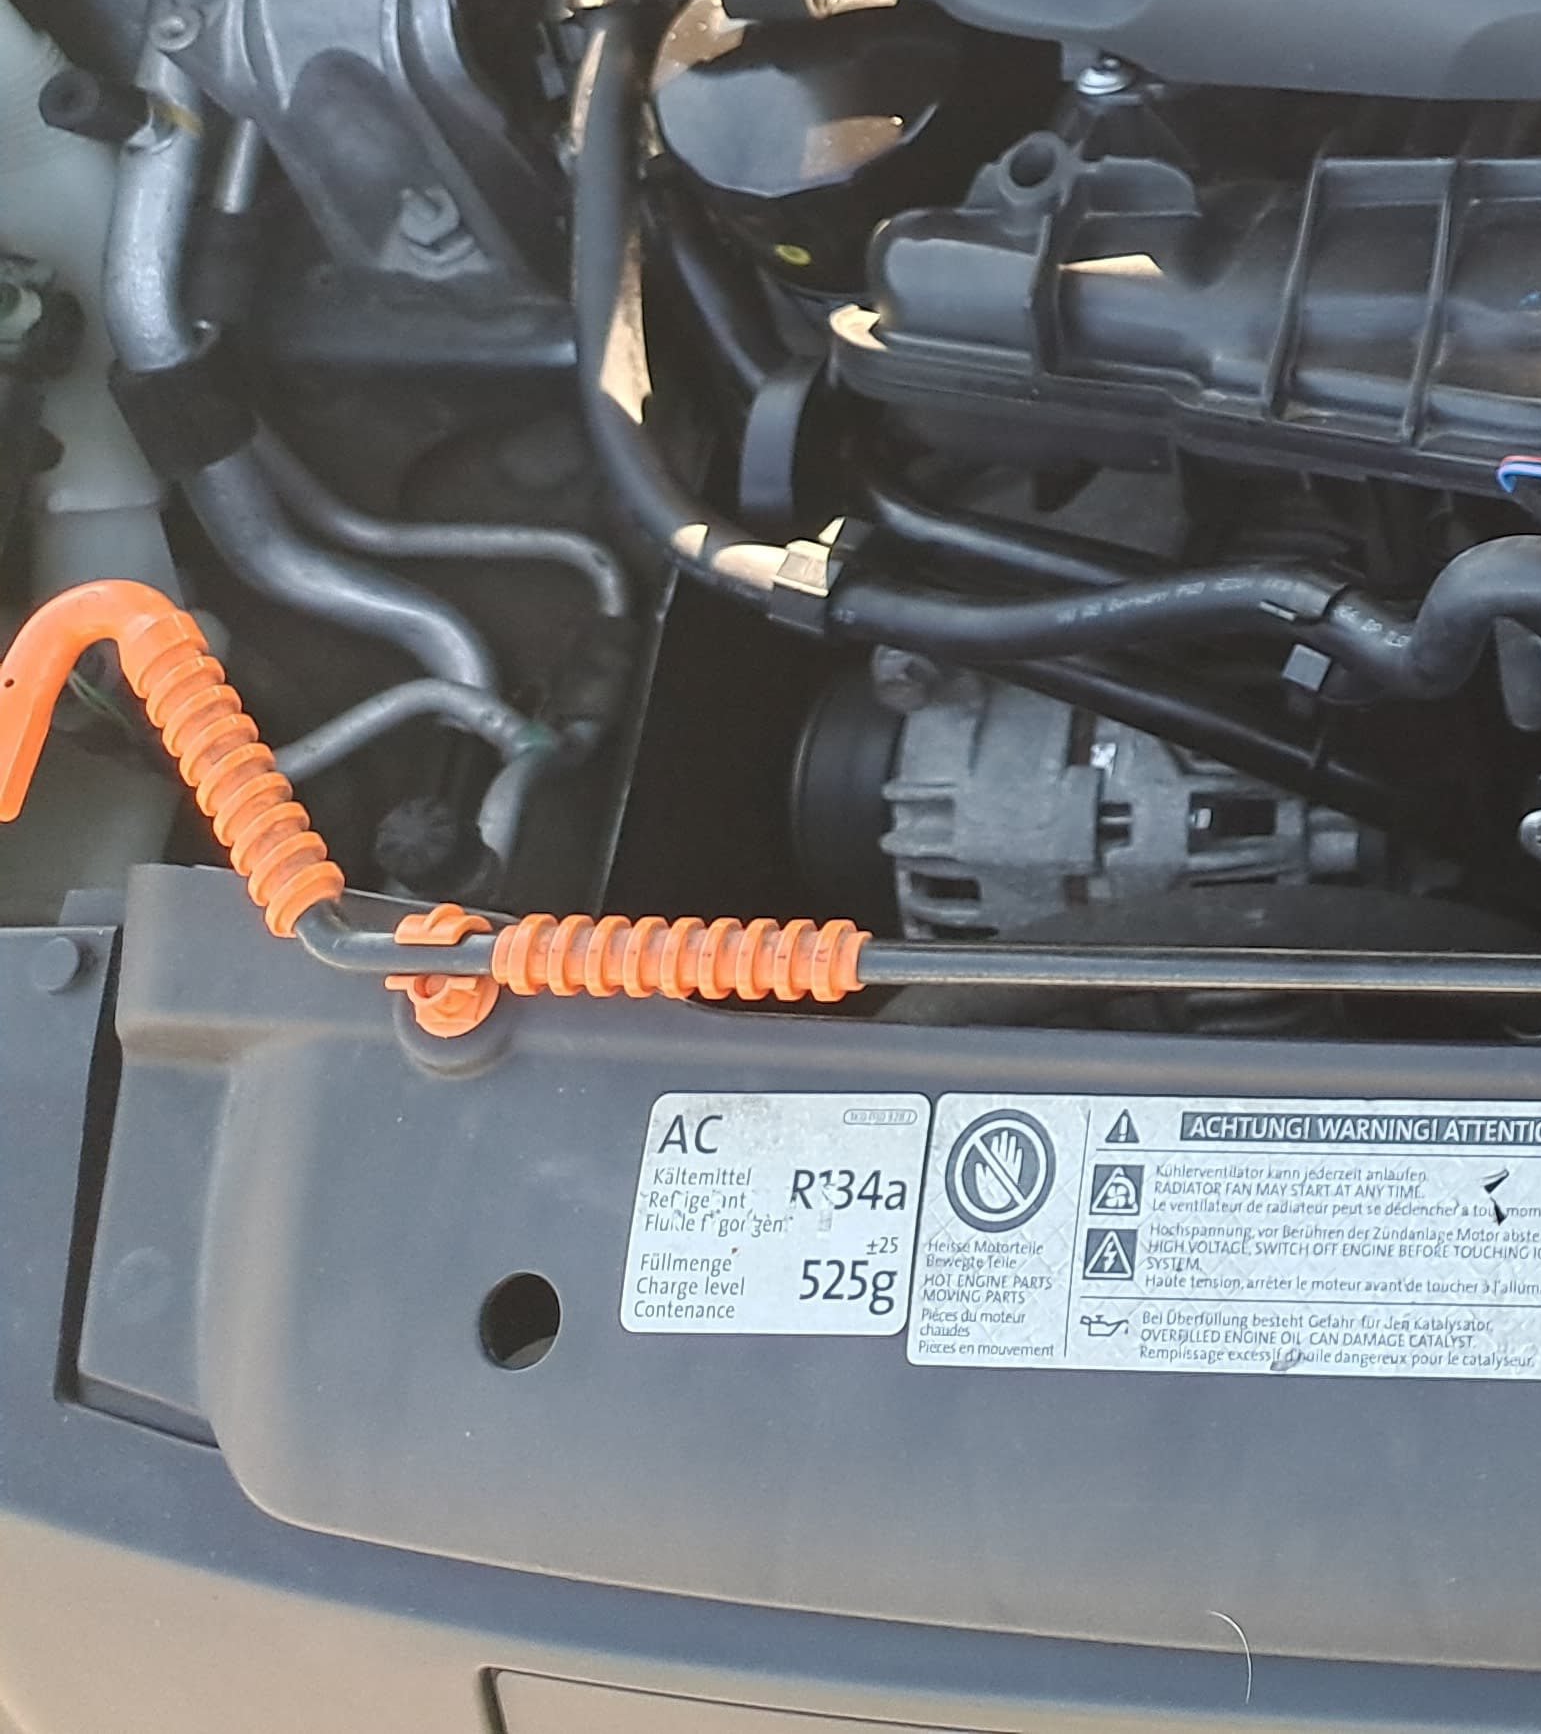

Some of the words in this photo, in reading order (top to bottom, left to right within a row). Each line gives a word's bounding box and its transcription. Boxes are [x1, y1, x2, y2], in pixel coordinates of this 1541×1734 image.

[657, 1114, 723, 1154] AC
[653, 1166, 752, 1186] Kältemittel
[1156, 1164, 1264, 1179] Kühlerventilator
[1267, 1165, 1300, 1180] kann
[1302, 1167, 1362, 1183] jederzeit
[1154, 1181, 1221, 1195] RADIATOR
[1225, 1182, 1253, 1196] FAN
[1257, 1183, 1286, 1197] MAY
[1290, 1183, 1331, 1197] START
[1335, 1184, 1352, 1197] AT
[1355, 1184, 1385, 1198] ANY
[1152, 1199, 1168, 1212] Le
[1170, 1200, 1243, 1214] ventilateur
[1246, 1201, 1263, 1214] de
[1266, 1201, 1329, 1215] radiateur
[1332, 1204, 1363, 1218] peut
[1367, 1205, 1384, 1215] se
[1258, 1227, 1279, 1237] vor
[1283, 1225, 1343, 1239] Berühren
[1348, 1227, 1369, 1239] der
[1373, 1228, 1453, 1244] Zündanlage
[1457, 1229, 1500, 1242] Motor
[866, 1236, 899, 1255] ±25
[974, 1241, 1043, 1256] Motorteile
[1147, 1240, 1185, 1253] HIGH
[1255, 1242, 1309, 1256] SWITCH
[1312, 1243, 1339, 1257] OFF
[1342, 1243, 1394, 1257] ENGINE
[1399, 1245, 1448, 1259] BEFORE
[1453, 1245, 1530, 1261] TOUCHING
[641, 1252, 732, 1278] Füllmenge
[988, 1255, 1017, 1269] Teile
[636, 1276, 698, 1301] Charge
[704, 1277, 745, 1296] level
[799, 1259, 898, 1316] 525g
[924, 1274, 951, 1287] HOT
[958, 1275, 1008, 1289] ENGINE
[1013, 1275, 1053, 1290] PARTS
[1145, 1276, 1186, 1288] Haute
[1189, 1276, 1244, 1291] tension,
[1295, 1278, 1308, 1290] le
[1311, 1279, 1363, 1292] moteur
[1365, 1280, 1404, 1292] avant
[1406, 1281, 1423, 1293] de
[1427, 1281, 1479, 1294] toucher
[923, 1289, 981, 1303] MOVING
[985, 1291, 1025, 1304] PARTS
[634, 1300, 735, 1319] Contenance
[961, 1312, 977, 1323] du
[980, 1313, 1025, 1324] moteur
[919, 1323, 970, 1337] chaudes
[1142, 1312, 1162, 1325] Bei
[1252, 1314, 1304, 1328] besteht
[1308, 1315, 1355, 1329] Gefahr
[1140, 1329, 1221, 1344] OVERFILLED
[1224, 1330, 1277, 1344] ENGINE
[1281, 1331, 1302, 1345] OIL
[1309, 1332, 1339, 1346] CAN
[1343, 1333, 1405, 1347] DAMAGE
[959, 1344, 974, 1355] en
[978, 1344, 1054, 1356] mouvement
[1140, 1346, 1225, 1362] Remplissage
[1228, 1348, 1282, 1362] excessif
[1335, 1351, 1407, 1368] dangereux
[1411, 1353, 1443, 1368] pour
[1447, 1353, 1459, 1365] le
[1462, 1355, 1535, 1370] catalyseur.
